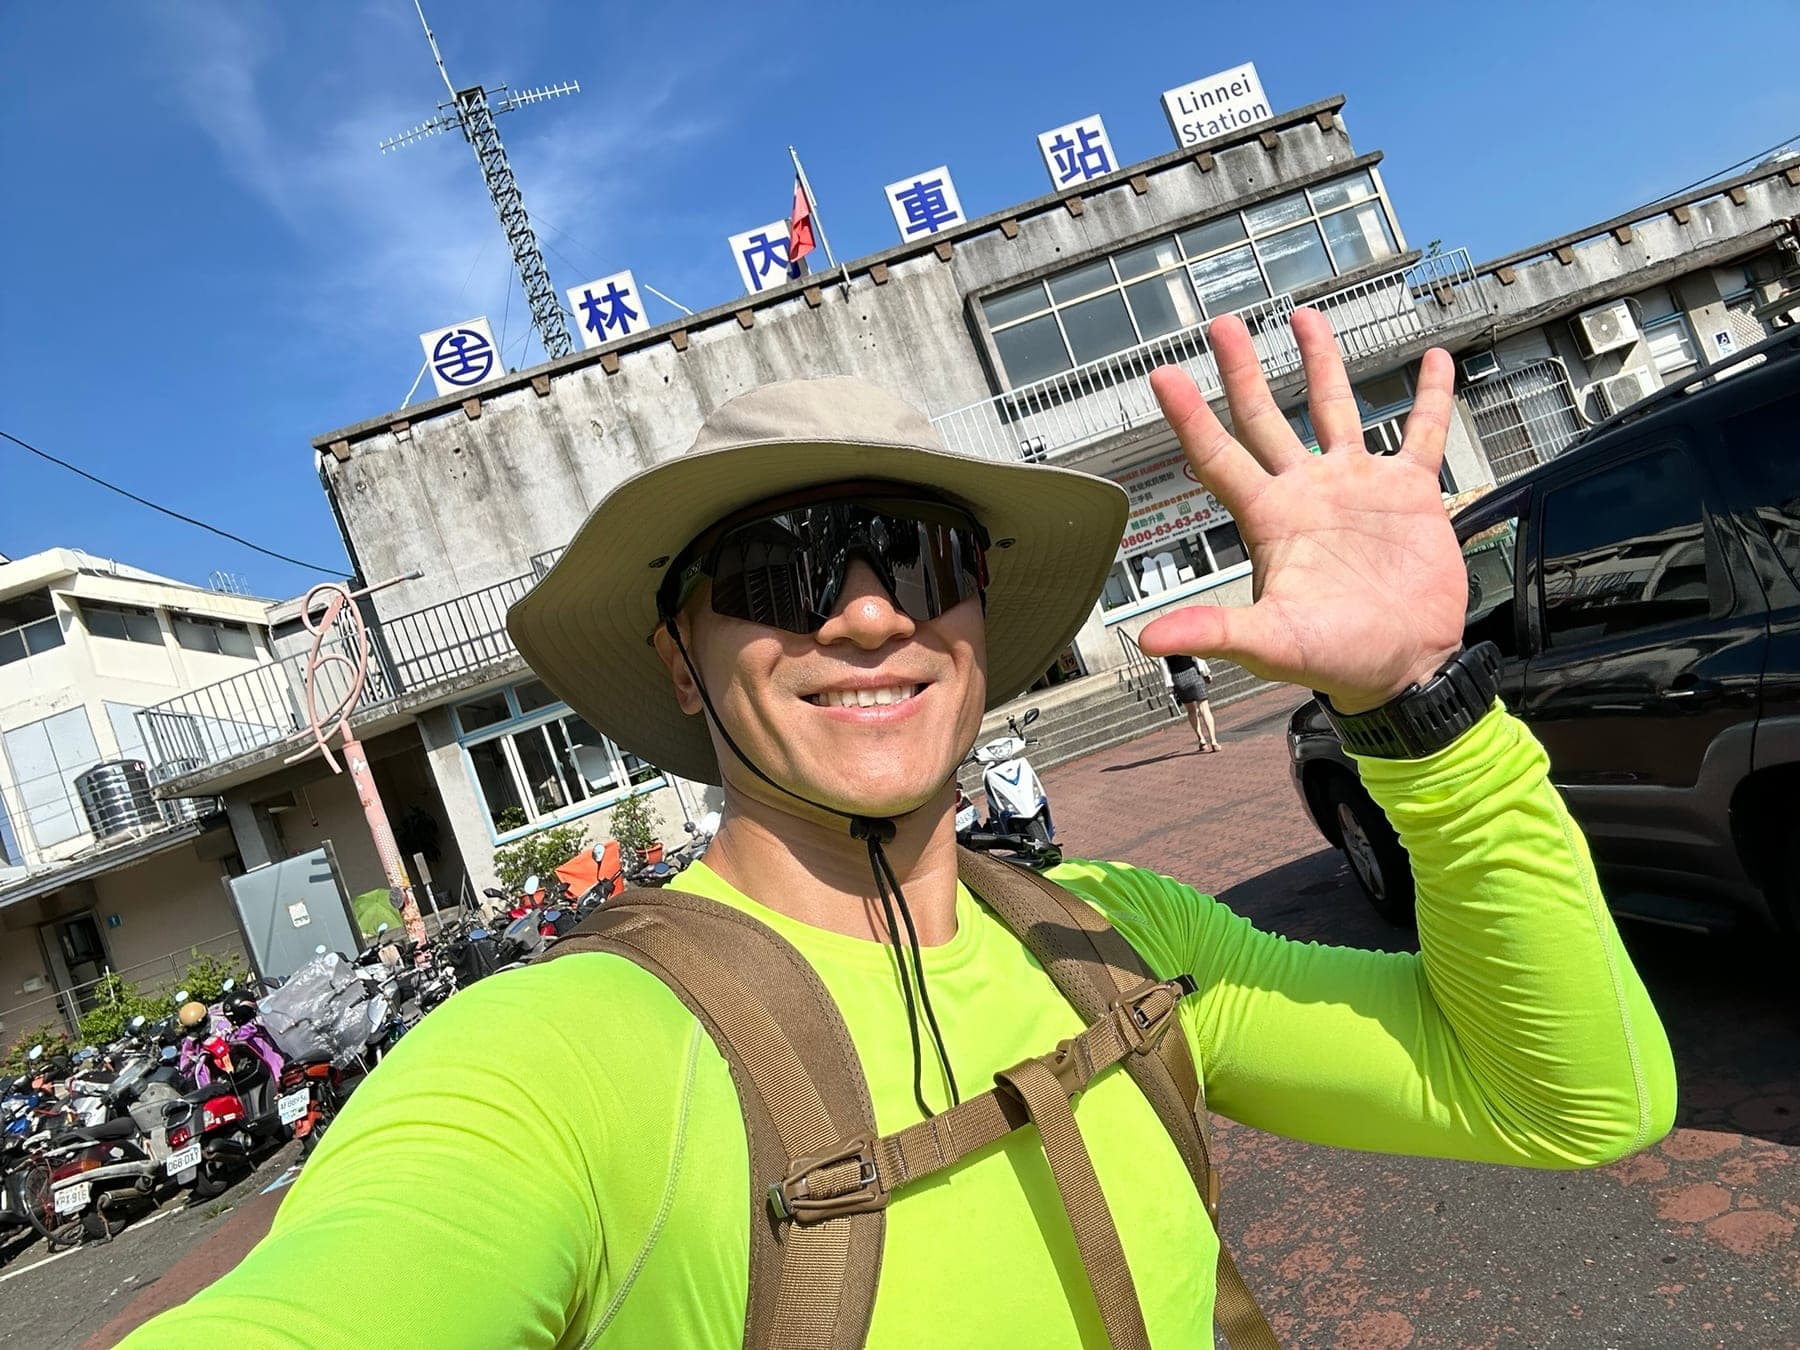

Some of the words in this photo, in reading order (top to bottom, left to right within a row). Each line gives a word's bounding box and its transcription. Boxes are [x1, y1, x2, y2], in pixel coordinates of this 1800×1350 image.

[1177, 73, 1251, 115] Linnei
[1182, 103, 1268, 143] Station
[1121, 508, 1212, 549] 0800-63-63-63
